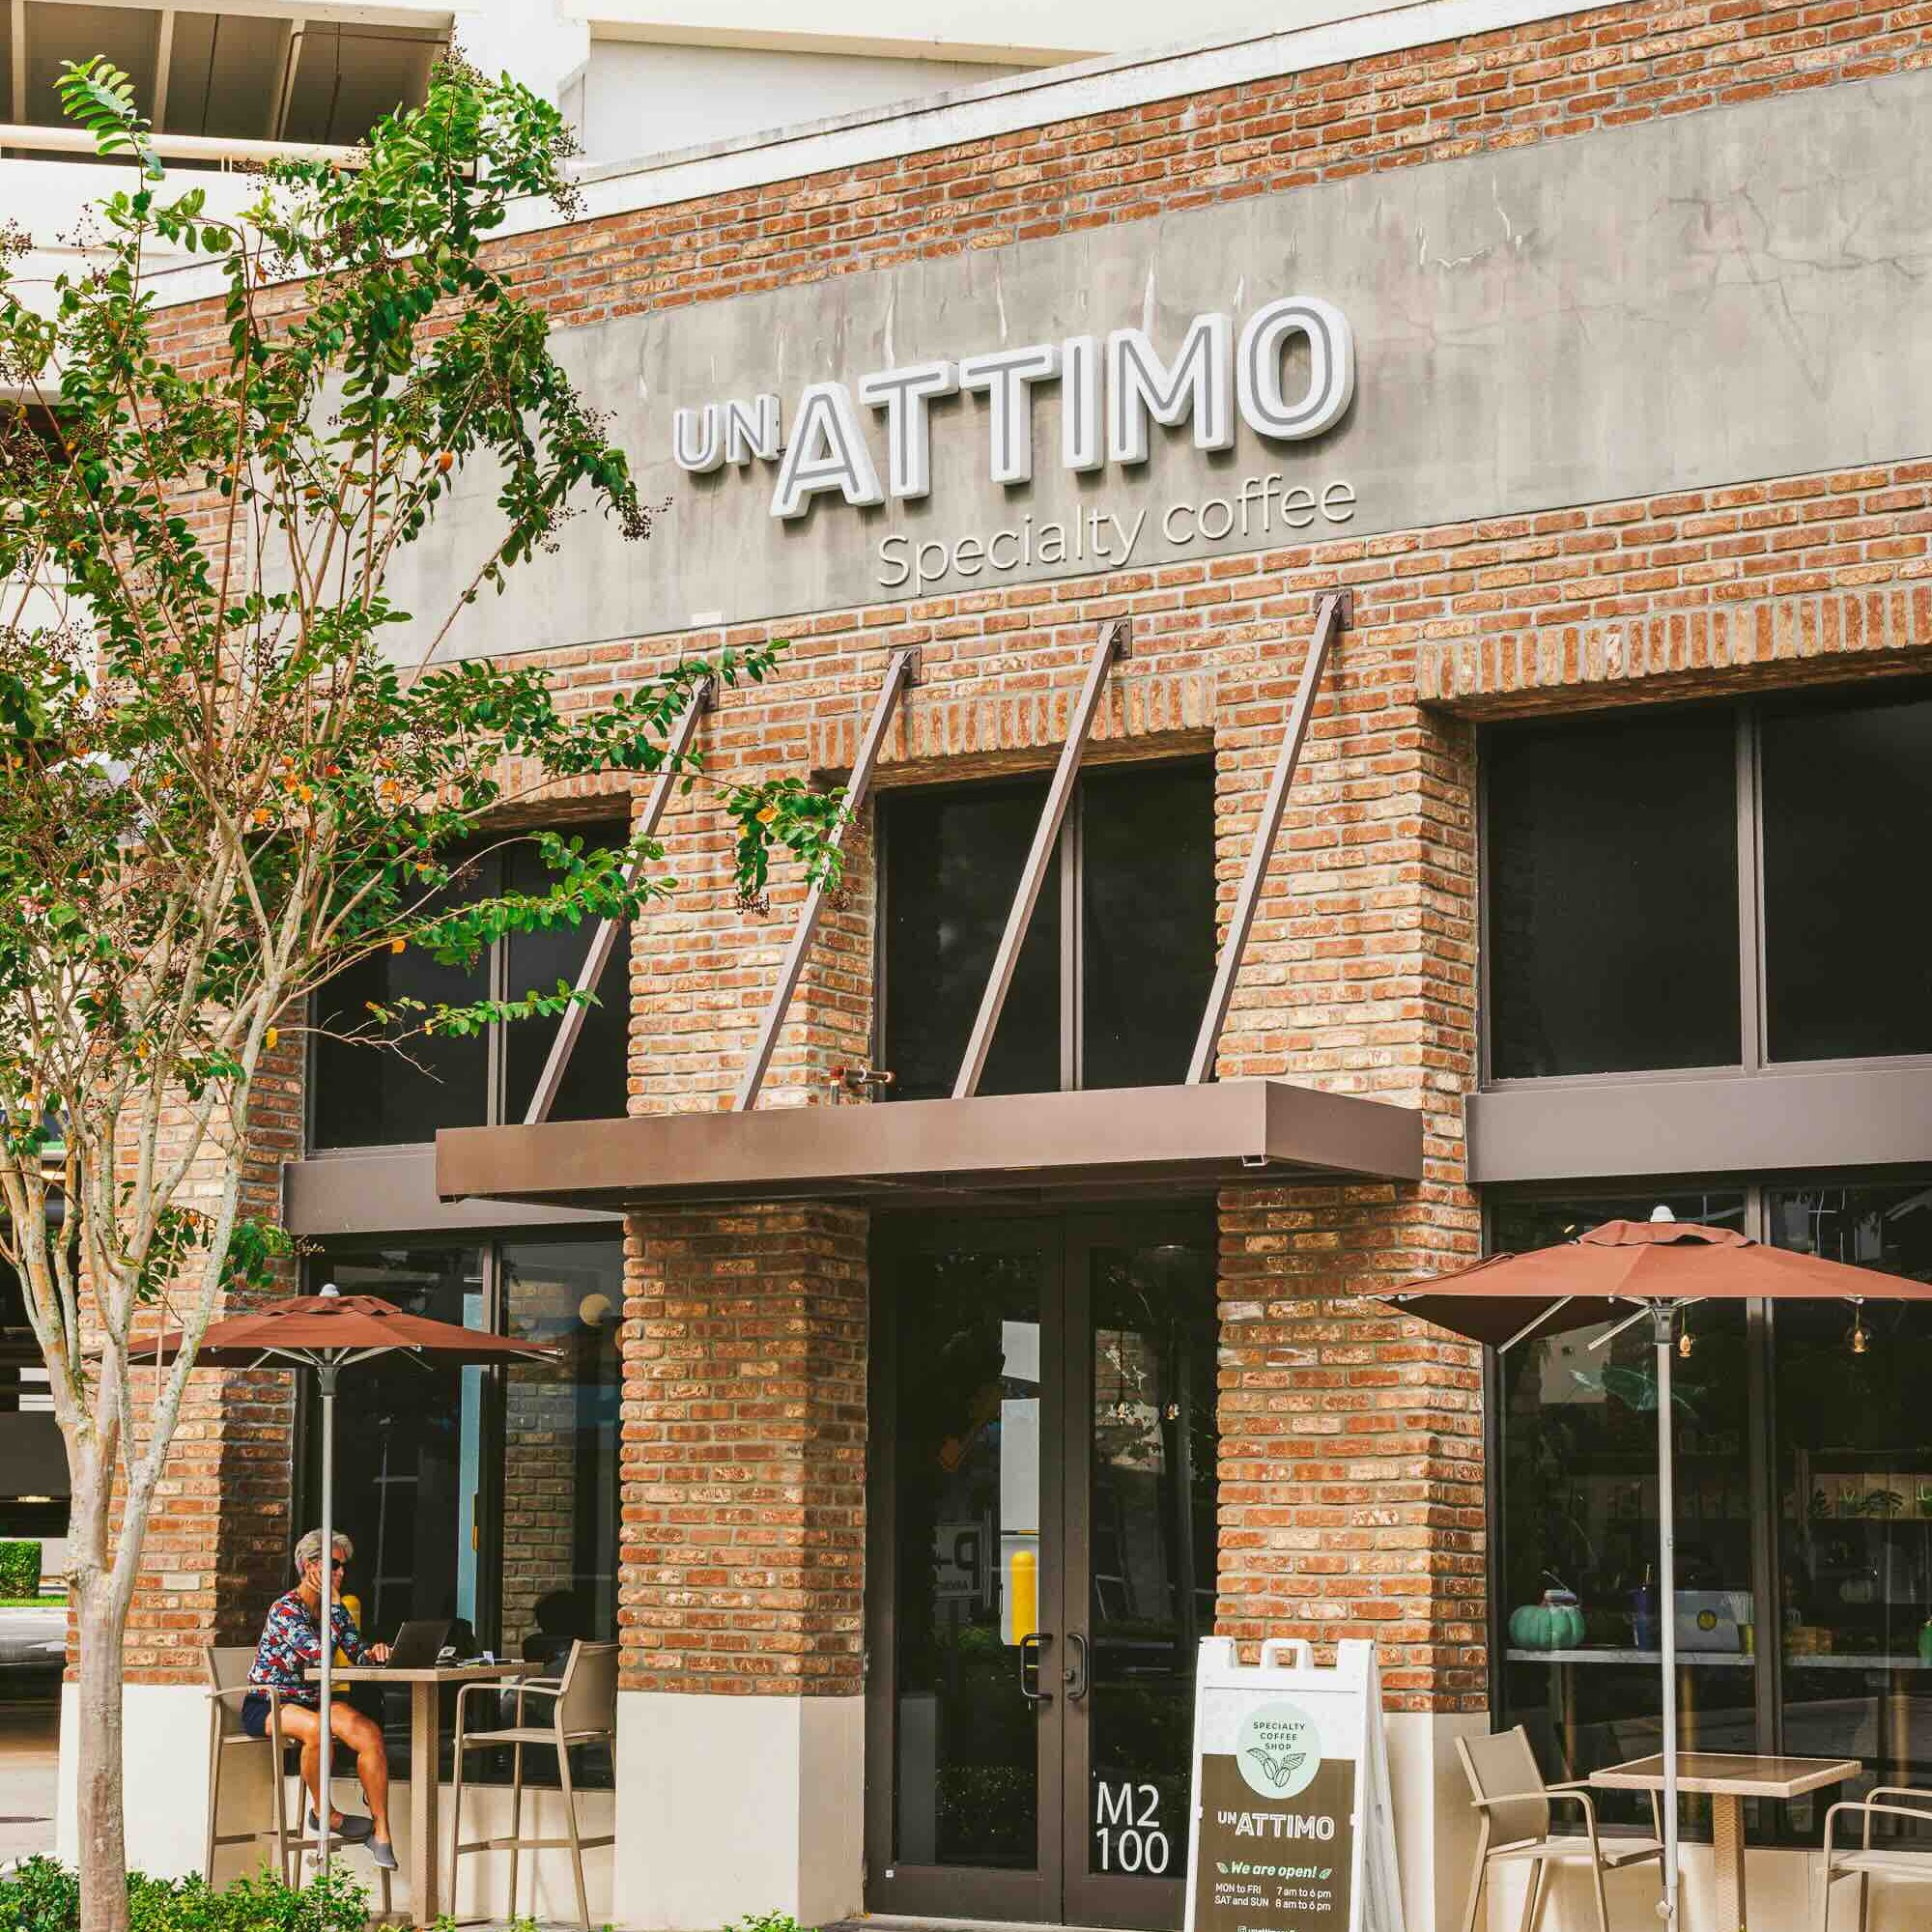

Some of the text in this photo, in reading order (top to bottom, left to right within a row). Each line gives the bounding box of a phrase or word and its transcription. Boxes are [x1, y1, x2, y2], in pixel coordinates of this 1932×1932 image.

[672, 295, 1356, 519] UN ATTIMO
[877, 473, 1356, 595] Specialty coffee
[1253, 1721, 1305, 1731] SPECIALTY
[1096, 1781, 1160, 1828] M2
[1217, 1811, 1335, 1840] UN ATTIMO
[1095, 1828, 1169, 1873] 100
[1231, 1861, 1317, 1880] We are open!
[1214, 1895, 1232, 1905] SAT
[1232, 1896, 1248, 1906] and
[1250, 1897, 1269, 1908] SUN
[1283, 1900, 1296, 1909] am
[1298, 1900, 1308, 1910] to
[1317, 1902, 1331, 1912] pm
[1215, 1883, 1236, 1893] MON
[1236, 1884, 1246, 1893] to
[1247, 1885, 1262, 1894] FRI
[1276, 1887, 1283, 1896] 7
[1298, 1888, 1308, 1897] to
[1309, 1888, 1316, 1898] 6
[1317, 1889, 1331, 1899] pm
